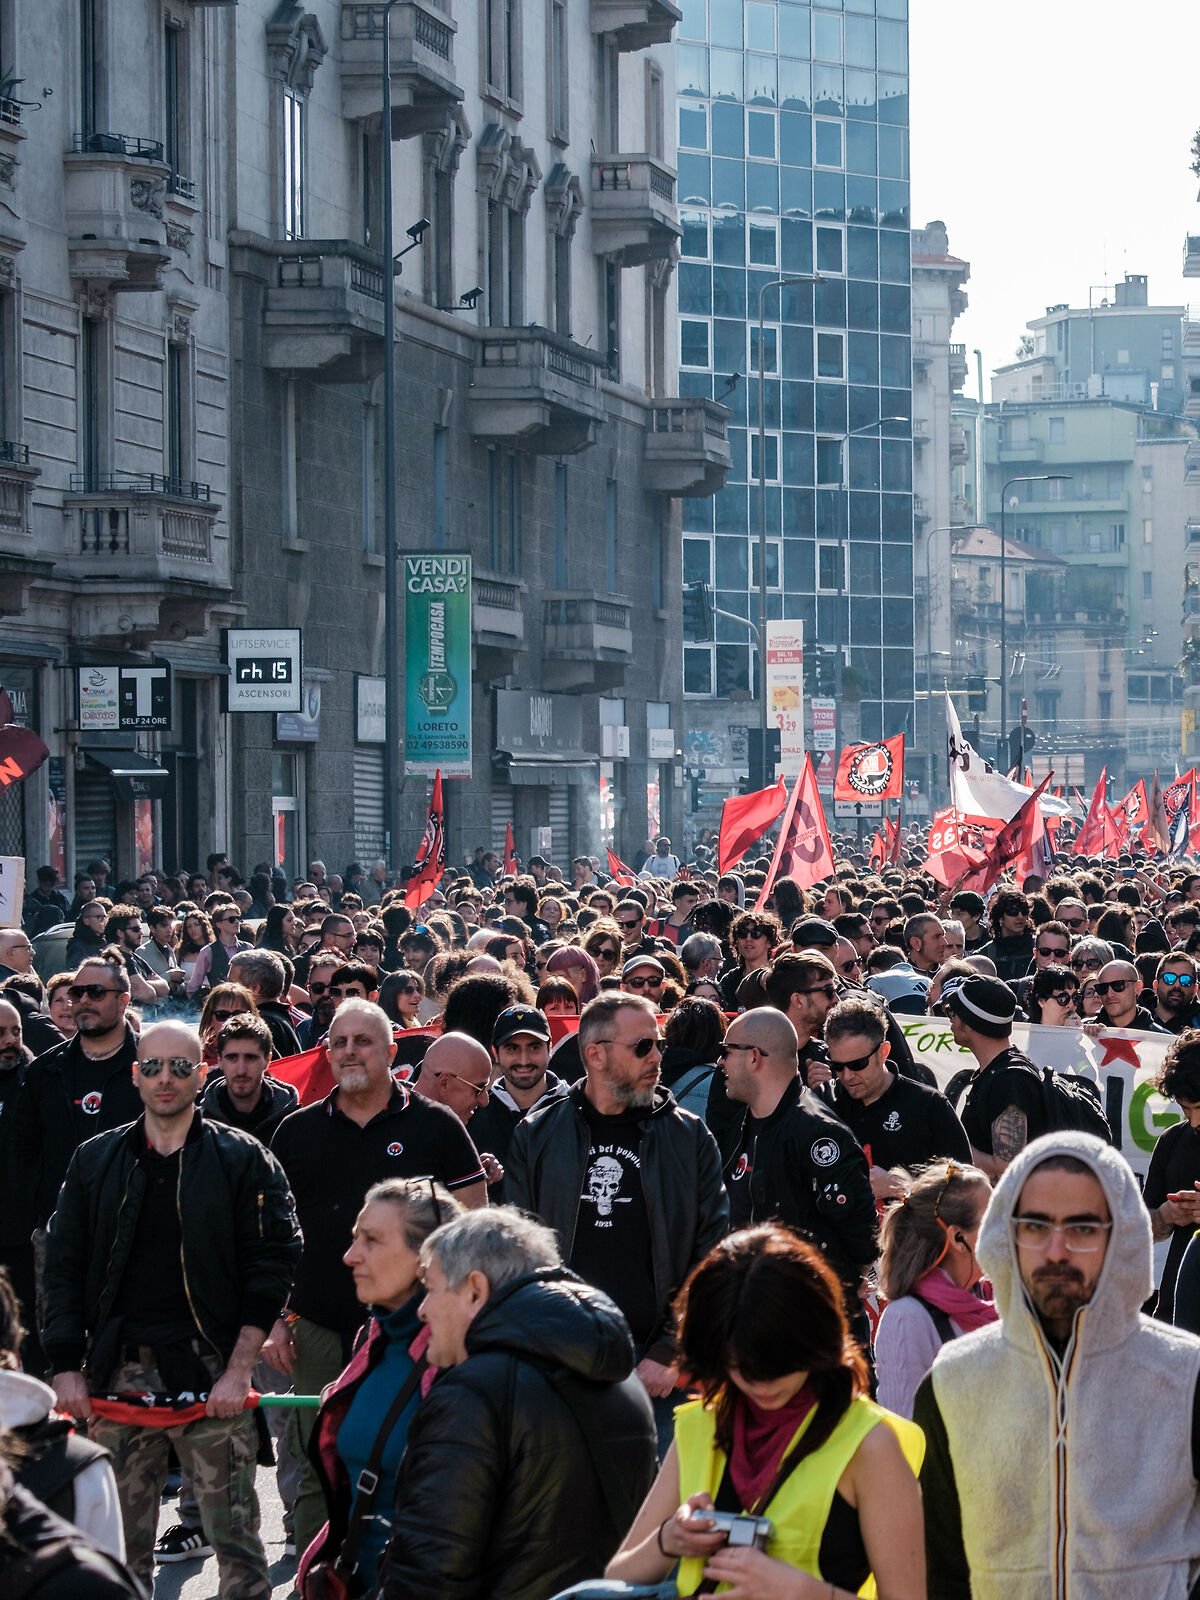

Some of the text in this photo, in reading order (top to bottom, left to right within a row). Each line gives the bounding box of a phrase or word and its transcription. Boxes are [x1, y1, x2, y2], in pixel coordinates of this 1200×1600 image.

[407, 559, 467, 575] VENDI
[408, 577, 467, 593] CASA?
[430, 602, 445, 667] TEMPOCASA
[241, 662, 287, 679] rh 15
[238, 690, 291, 698] ASCENSORI
[418, 722, 458, 731] LORETO
[407, 741, 469, 749] 02 49538590
[598, 1144, 614, 1153] del
